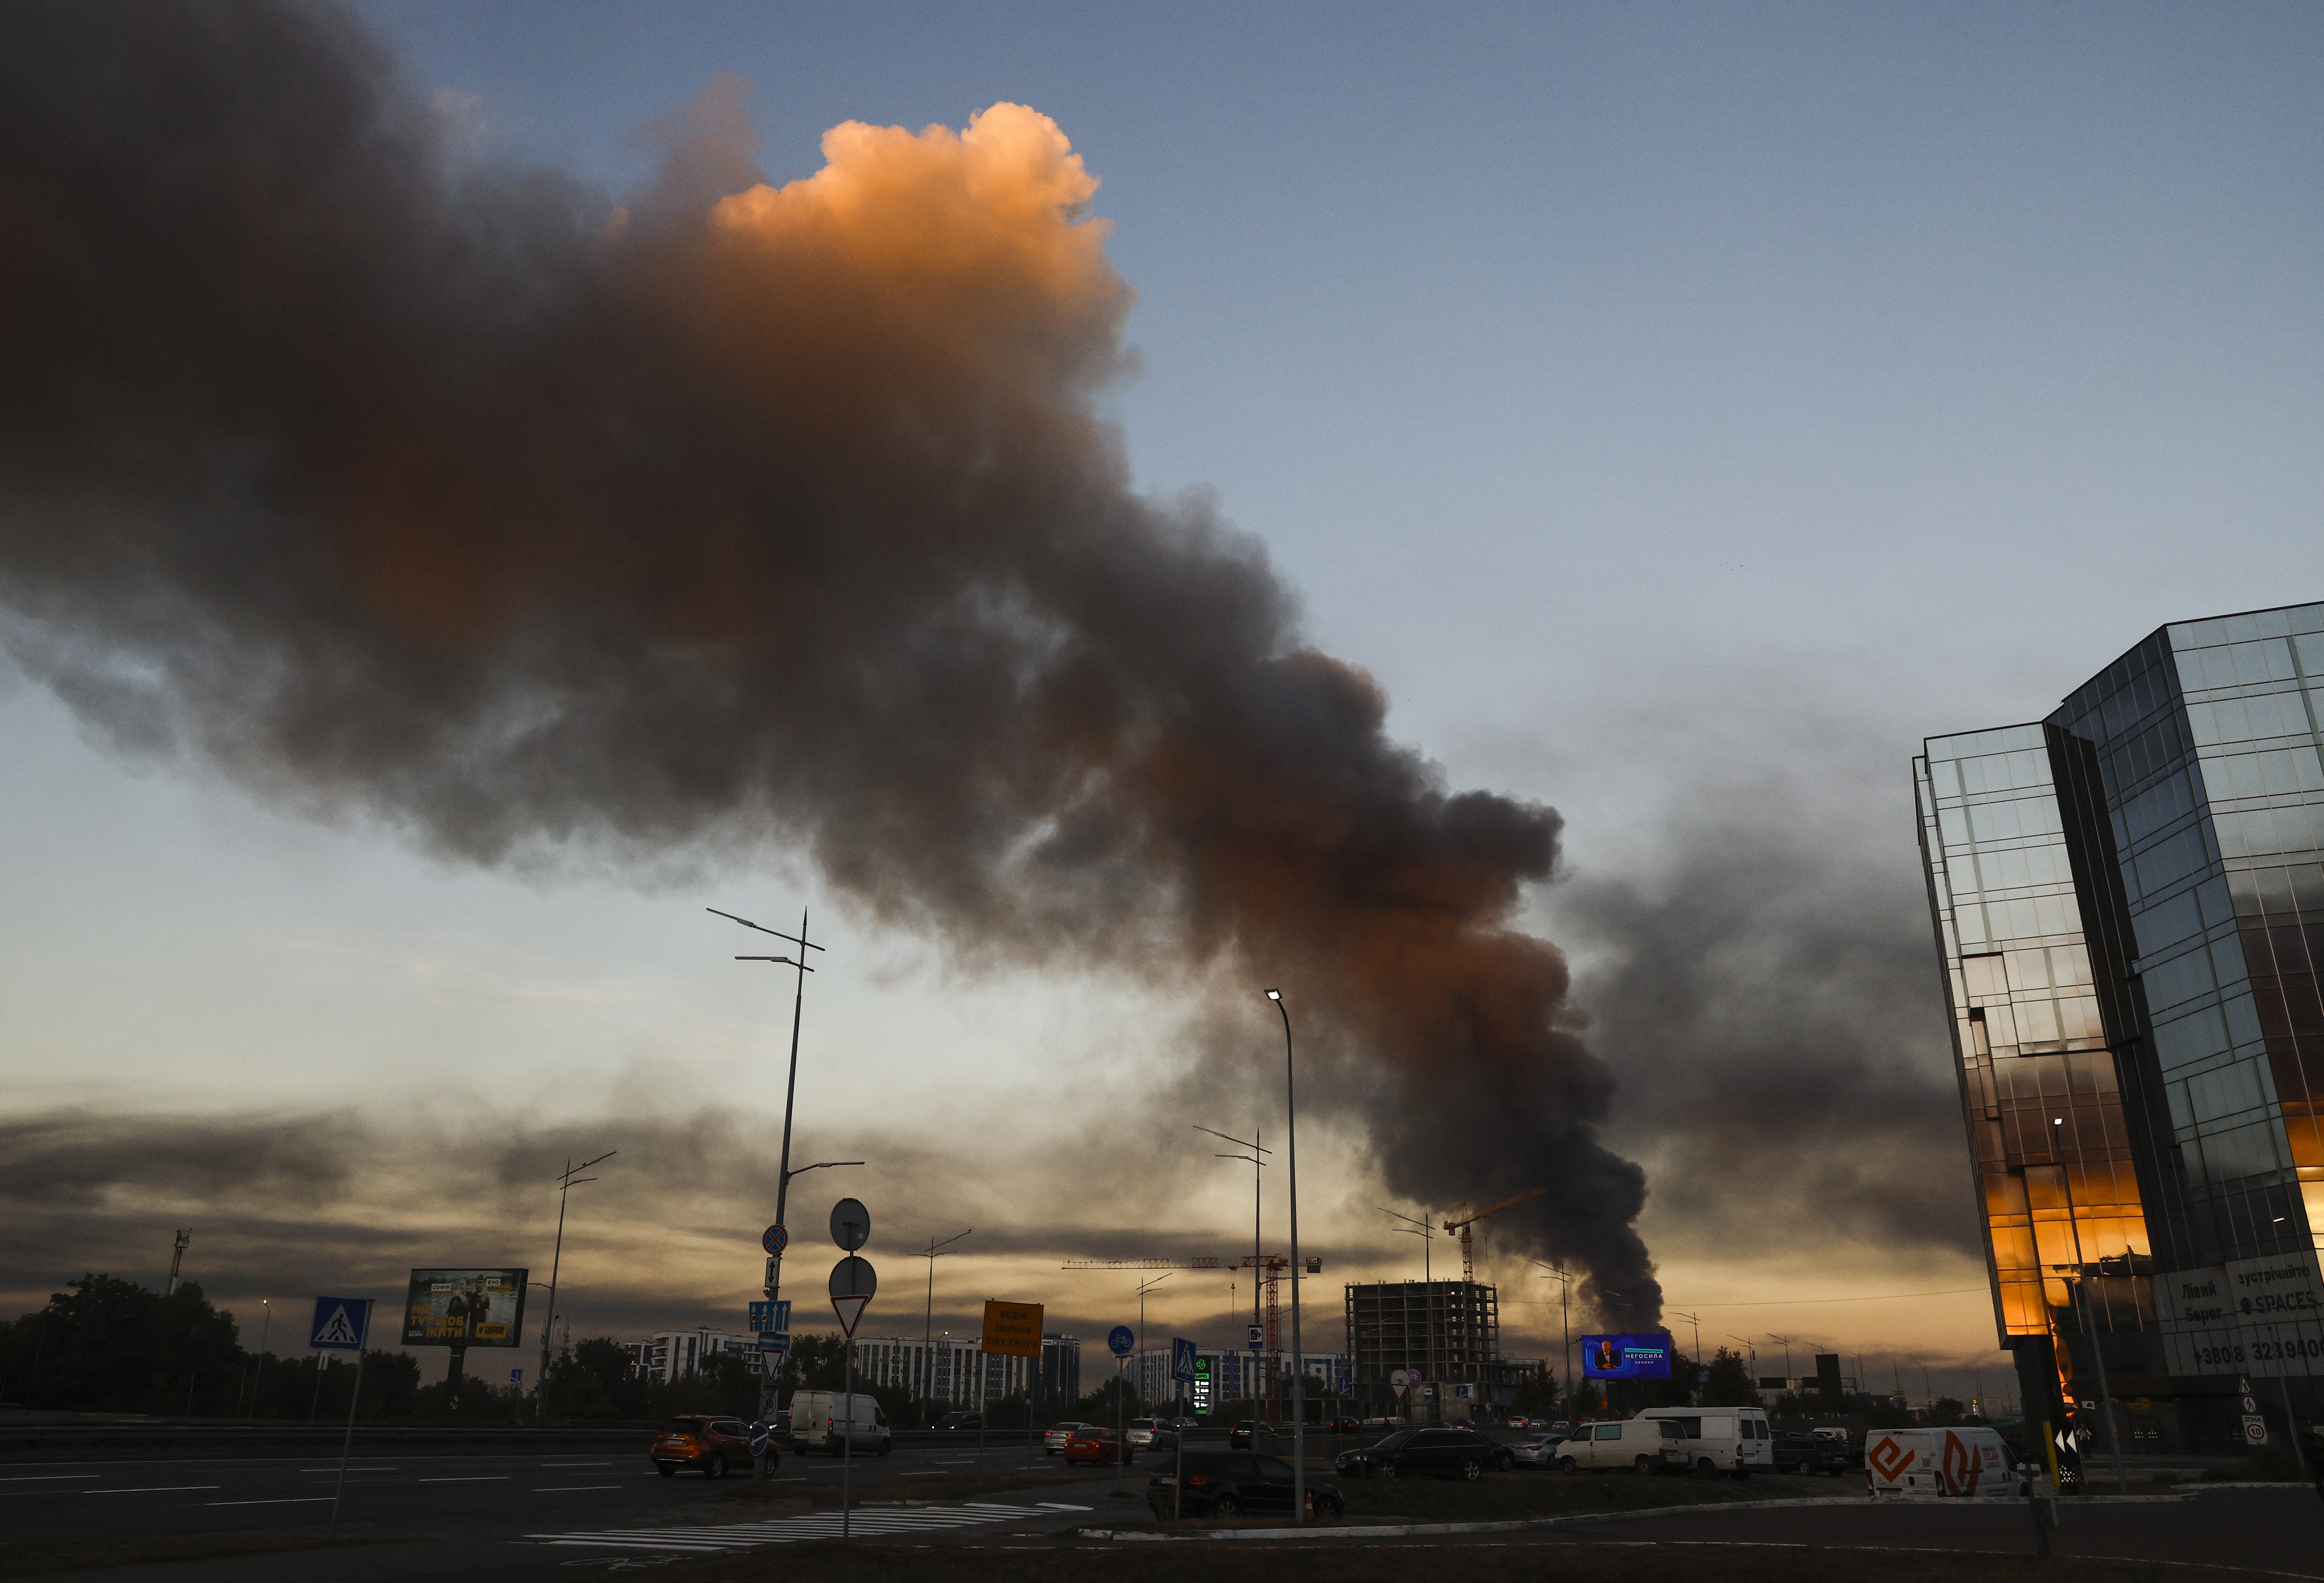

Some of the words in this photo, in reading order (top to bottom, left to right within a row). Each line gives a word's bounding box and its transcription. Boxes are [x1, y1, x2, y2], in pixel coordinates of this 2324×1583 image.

[2238, 1264, 2310, 1287] зустрічайте
[2182, 1281, 2217, 1299] Лівий
[1001, 1310, 1027, 1320] ВОДІЙ
[2185, 1308, 2222, 1325] Берег
[435, 1316, 464, 1327] ЩОБ
[426, 1327, 463, 1338] ЖИТИ
[995, 1324, 1031, 1334] ЗВІЛЬНИ
[985, 1338, 1006, 1346] ЛІВУ
[1009, 1339, 1038, 1349] СМУГУ
[765, 1399, 773, 1408] 10
[1983, 1452, 1999, 1461] SOLAR
